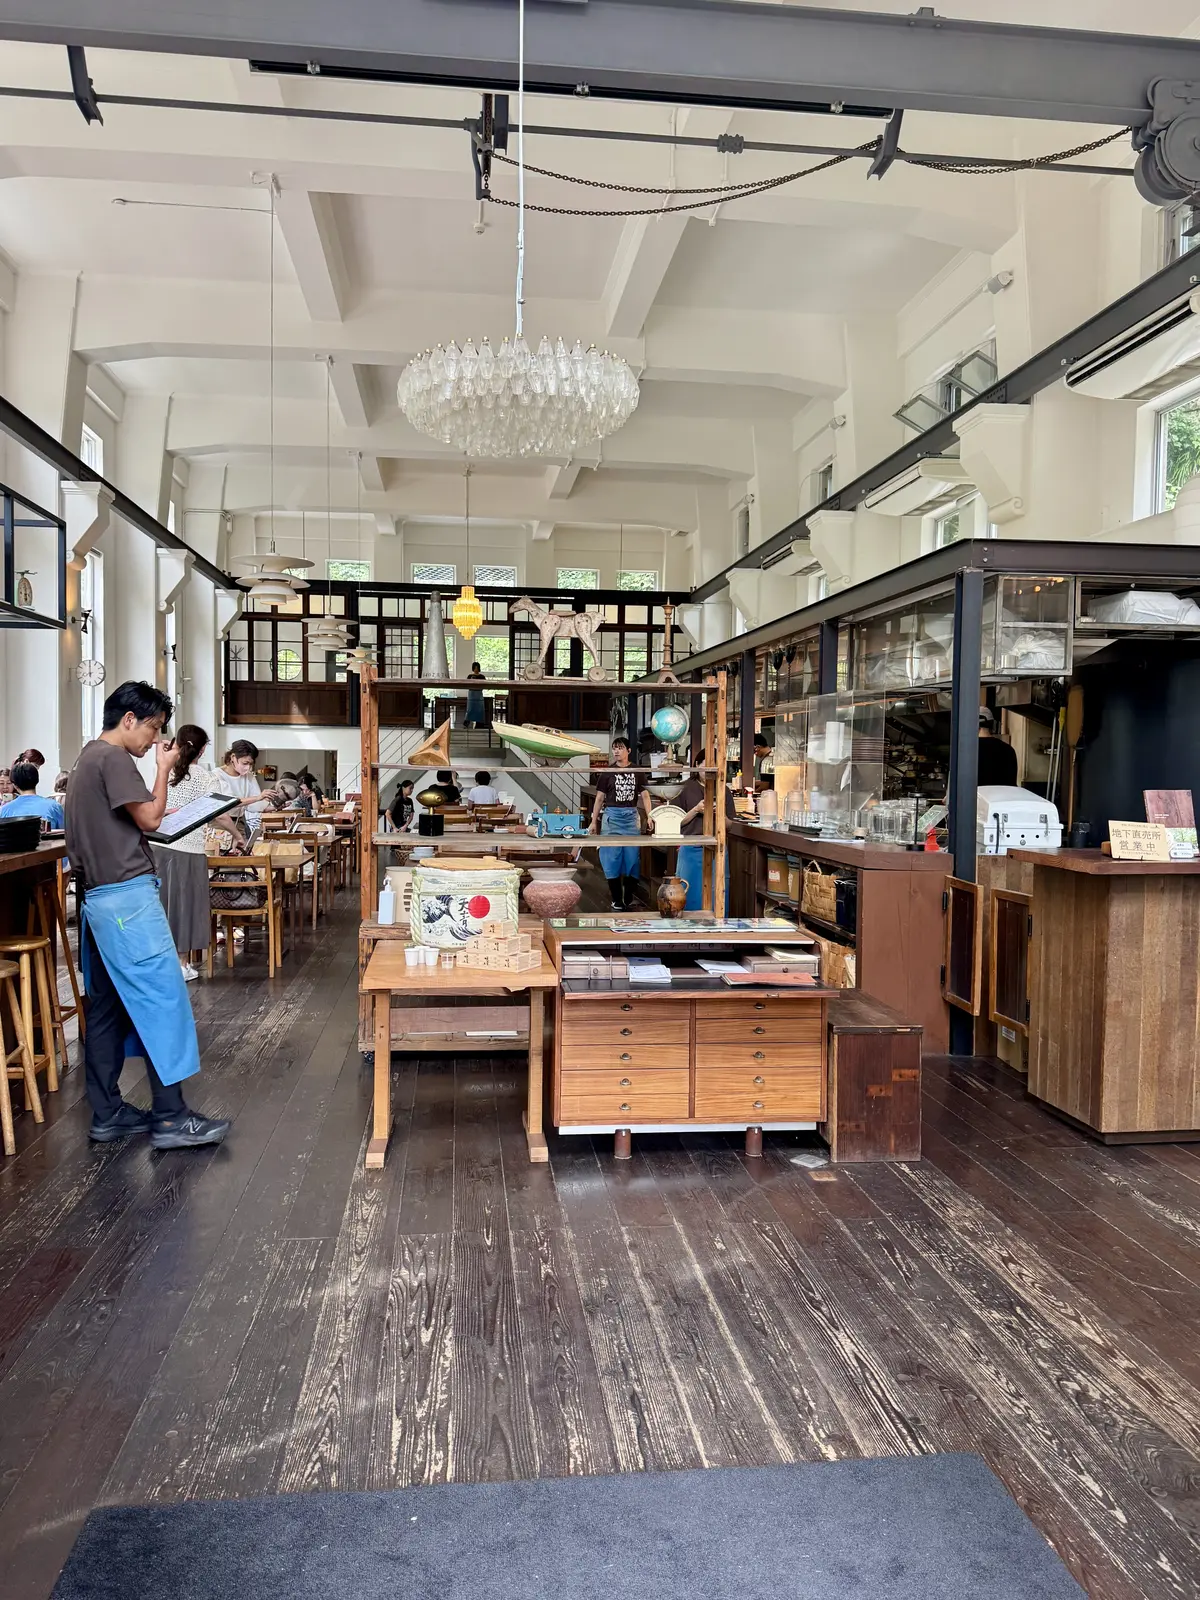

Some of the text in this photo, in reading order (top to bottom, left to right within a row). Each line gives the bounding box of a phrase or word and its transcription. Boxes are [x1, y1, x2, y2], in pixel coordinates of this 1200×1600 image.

[1112, 829, 1161, 840] 地下直売所
[1119, 840, 1155, 852] 営業中
